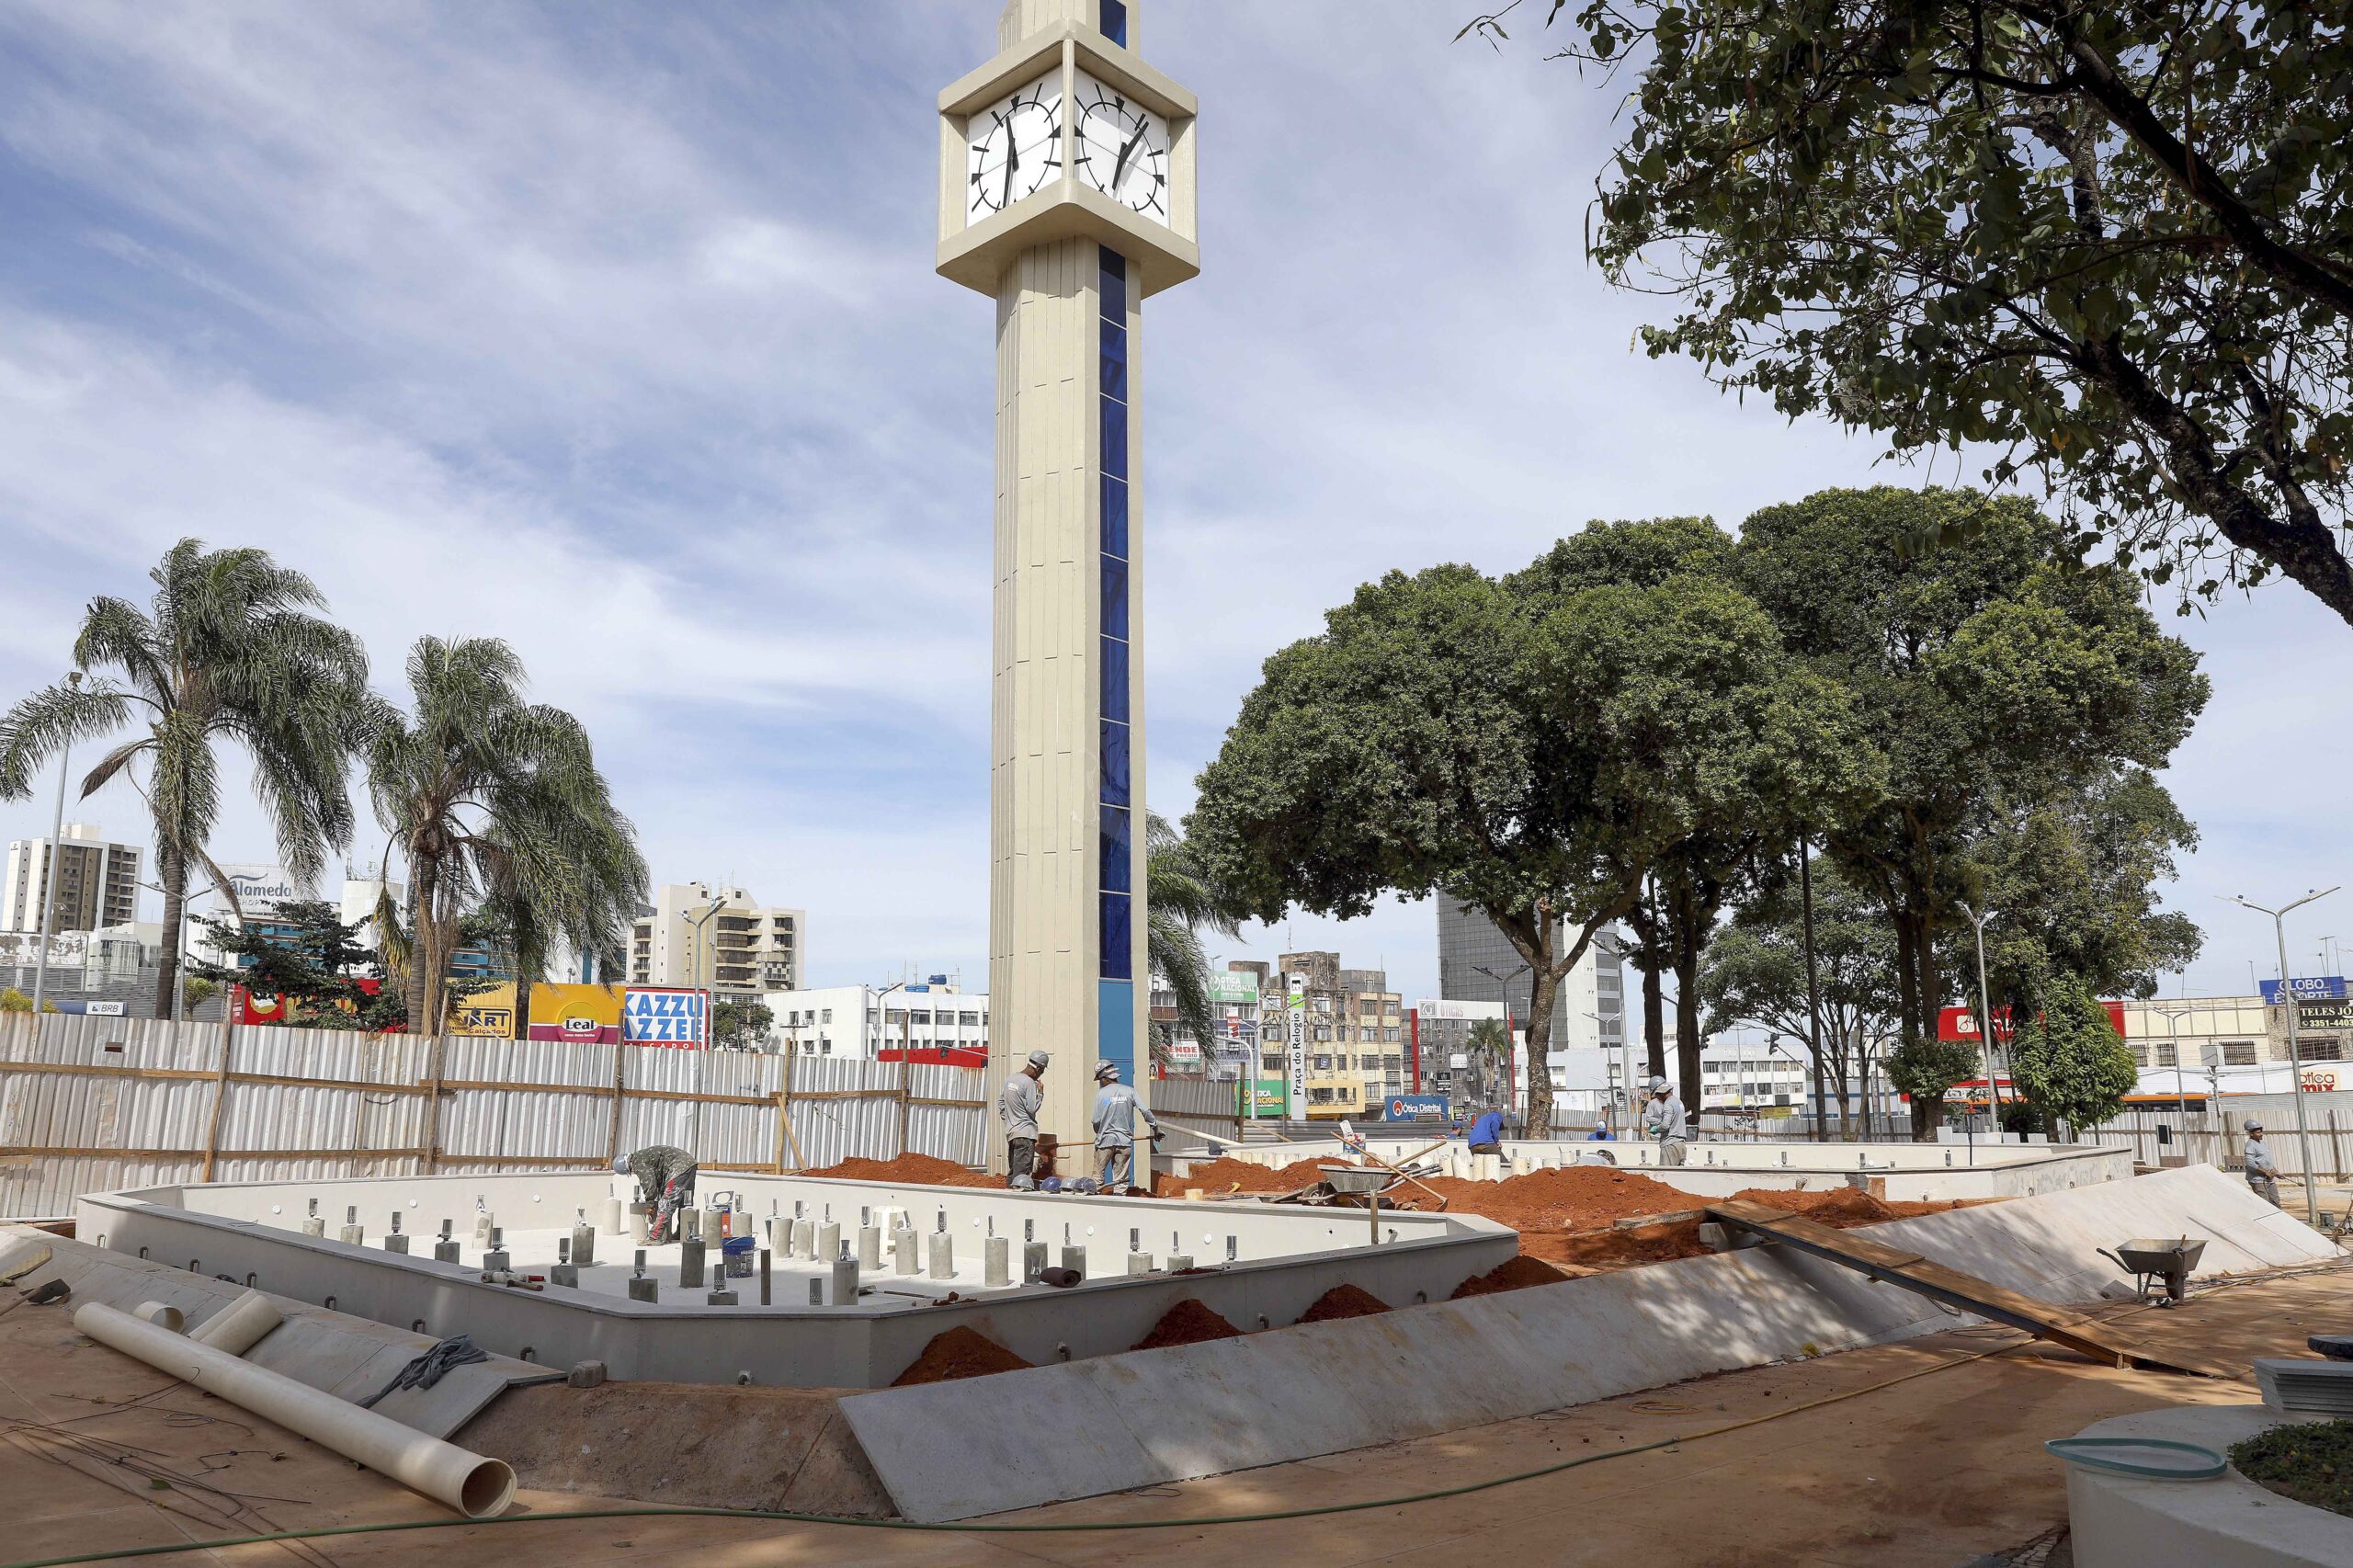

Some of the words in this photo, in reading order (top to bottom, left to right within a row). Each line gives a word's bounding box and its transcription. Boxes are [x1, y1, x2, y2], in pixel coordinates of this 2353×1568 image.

[230, 881, 291, 897] Alameda
[1221, 983, 1256, 993] NACIONAL
[101, 1004, 119, 1013] BRB
[2299, 1006, 2336, 1017] TELES
[2337, 1006, 2353, 1017] JO
[565, 1019, 595, 1030] Leal
[2309, 1018, 2353, 1027] 3351-4403
[1291, 1013, 1303, 1050] Relogio
[1292, 1053, 1302, 1065] do
[1292, 1068, 1303, 1096] Praça
[2302, 1084, 2336, 1093] mix
[1403, 1101, 1418, 1113] Ótica
[1419, 1103, 1442, 1113] Distrital
